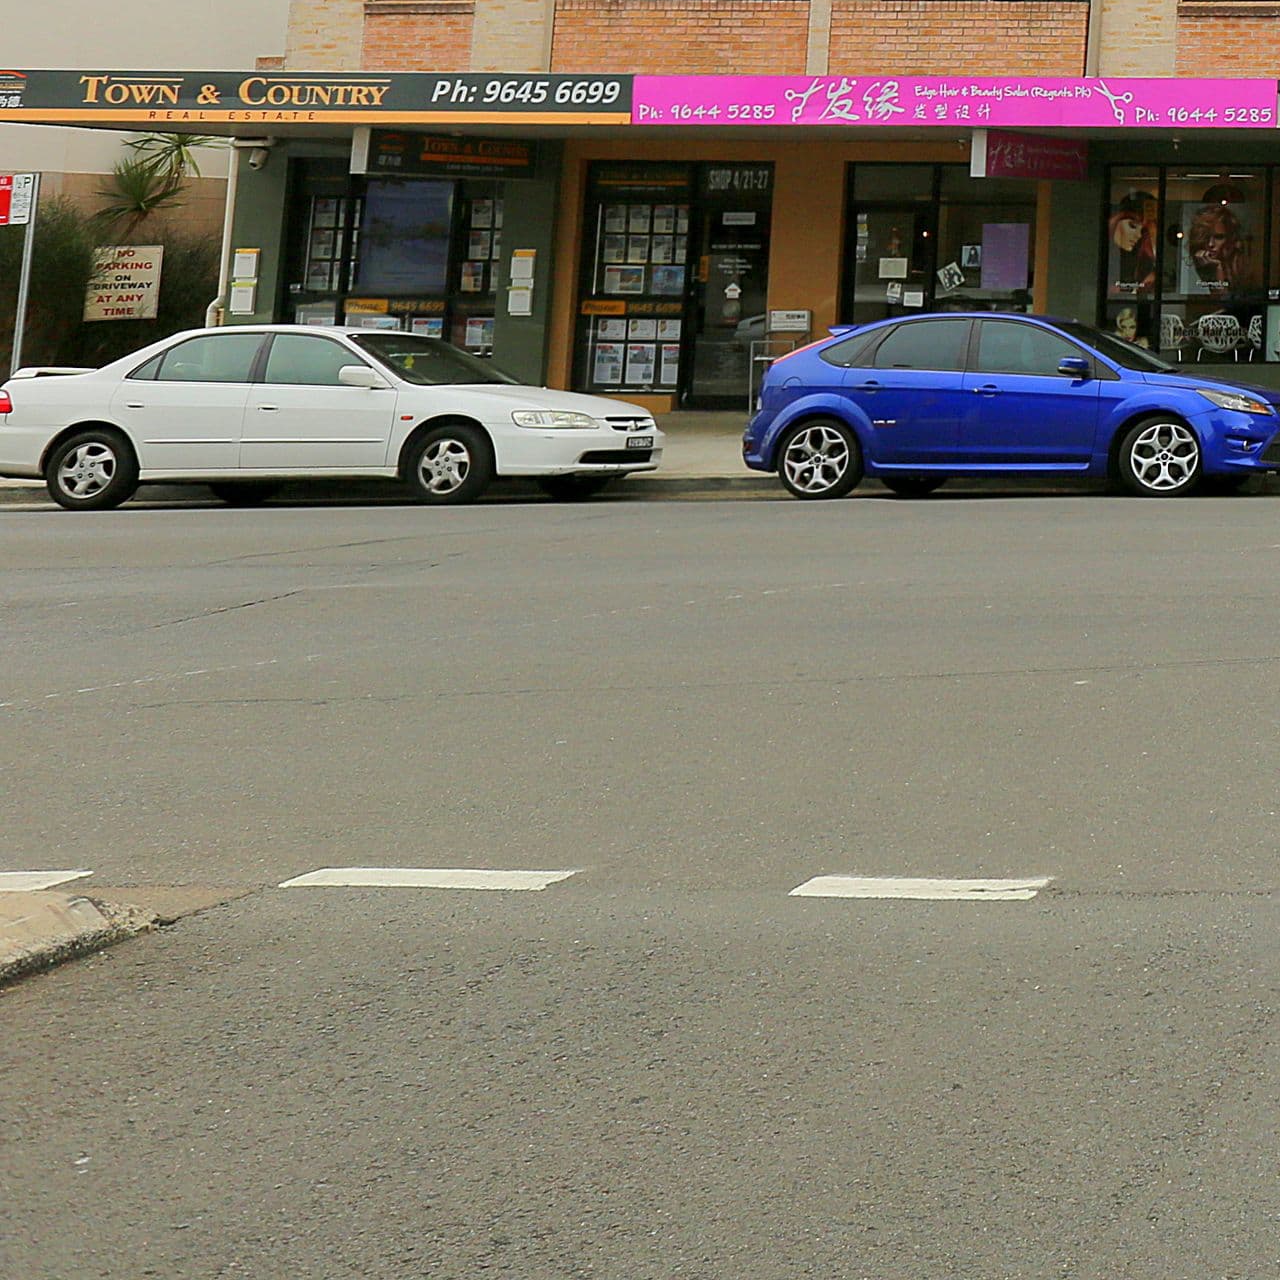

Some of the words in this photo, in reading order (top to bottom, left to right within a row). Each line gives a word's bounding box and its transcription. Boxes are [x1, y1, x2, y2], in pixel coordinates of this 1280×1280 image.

[80, 75, 182, 104] TOWN
[196, 84, 221, 105] &
[238, 77, 390, 106] COUNTRY
[431, 80, 476, 102] Ph:
[483, 81, 548, 103] 9645
[554, 81, 621, 104] 6699
[914, 86, 937, 99] Edge
[940, 84, 959, 96] Hair
[970, 86, 1003, 100] Beauty
[1004, 86, 1029, 97] Salon
[149, 111, 206, 120] REAL
[228, 111, 316, 121] ESTATE
[639, 104, 663, 119] Ph:
[671, 104, 721, 119] 9644
[727, 104, 776, 120] 5285
[1135, 107, 1160, 122] Ph:
[1167, 107, 1217, 123] 9644
[1223, 107, 1272, 123] 5285
[709, 170, 732, 190] SHOP
[116, 250, 136, 258] NO
[95, 262, 153, 271] PARKING
[114, 274, 132, 282] ON
[93, 282, 153, 290] DRIVEWAY
[96, 295, 113, 304] AT
[116, 294, 144, 302] ANY
[103, 307, 135, 316] TIME
